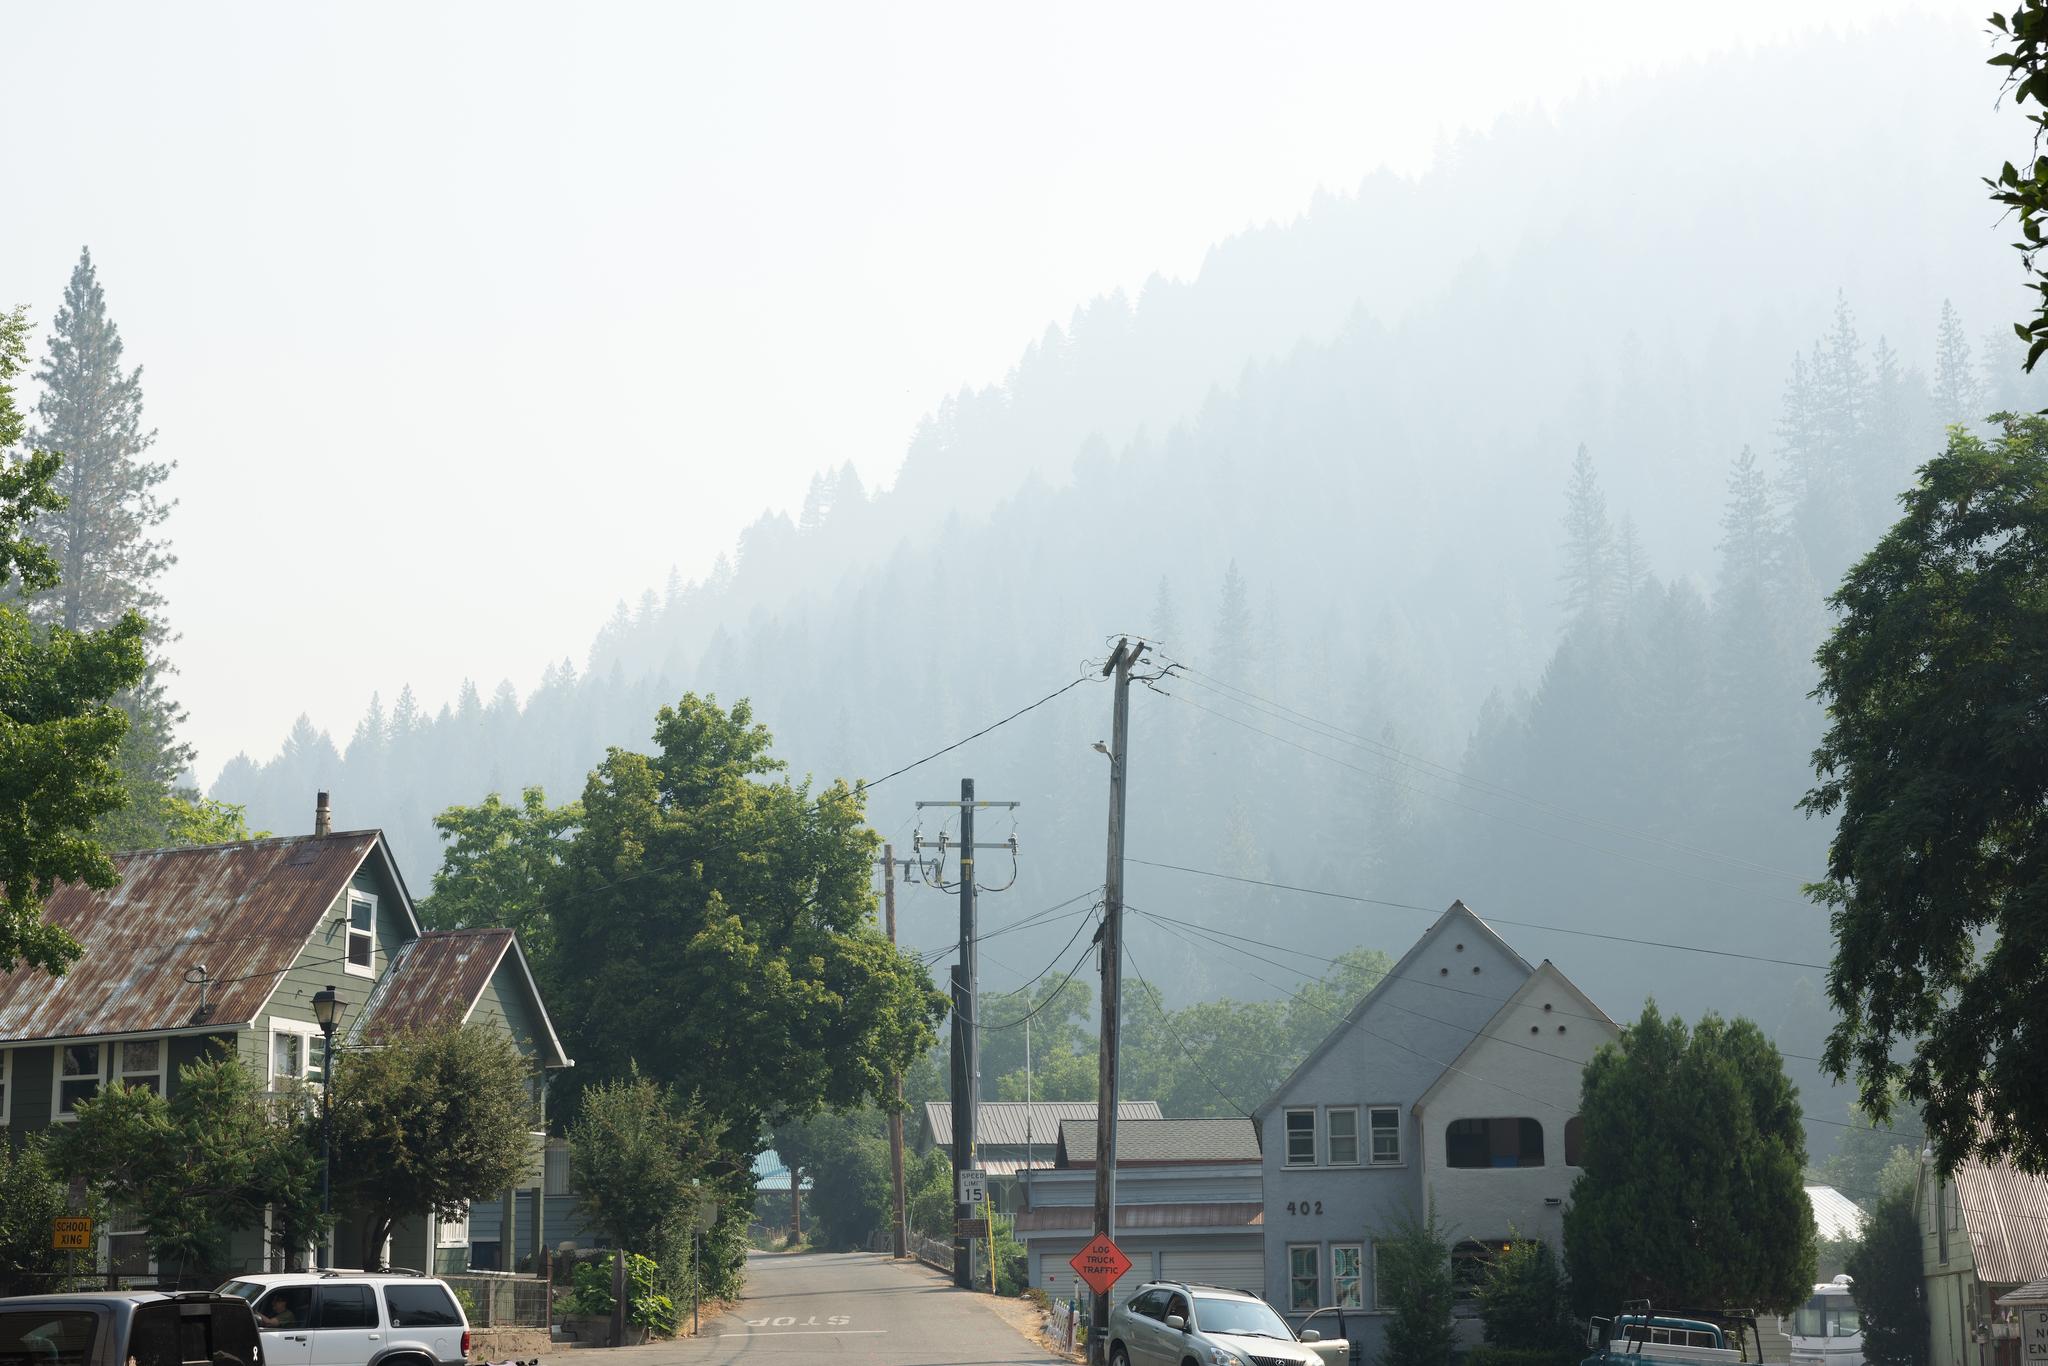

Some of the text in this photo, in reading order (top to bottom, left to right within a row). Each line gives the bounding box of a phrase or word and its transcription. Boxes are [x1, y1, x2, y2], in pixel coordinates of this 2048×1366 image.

[966, 1189, 982, 1200] 15
[1286, 1201, 1323, 1216] 402
[57, 1222, 88, 1231] SCHOOL
[61, 1235, 82, 1244] XING
[1092, 1246, 1110, 1254] LOG
[1087, 1256, 1115, 1264] TRUCK
[1083, 1266, 1119, 1274] TRAFFIC
[745, 1316, 850, 1327] STOP
